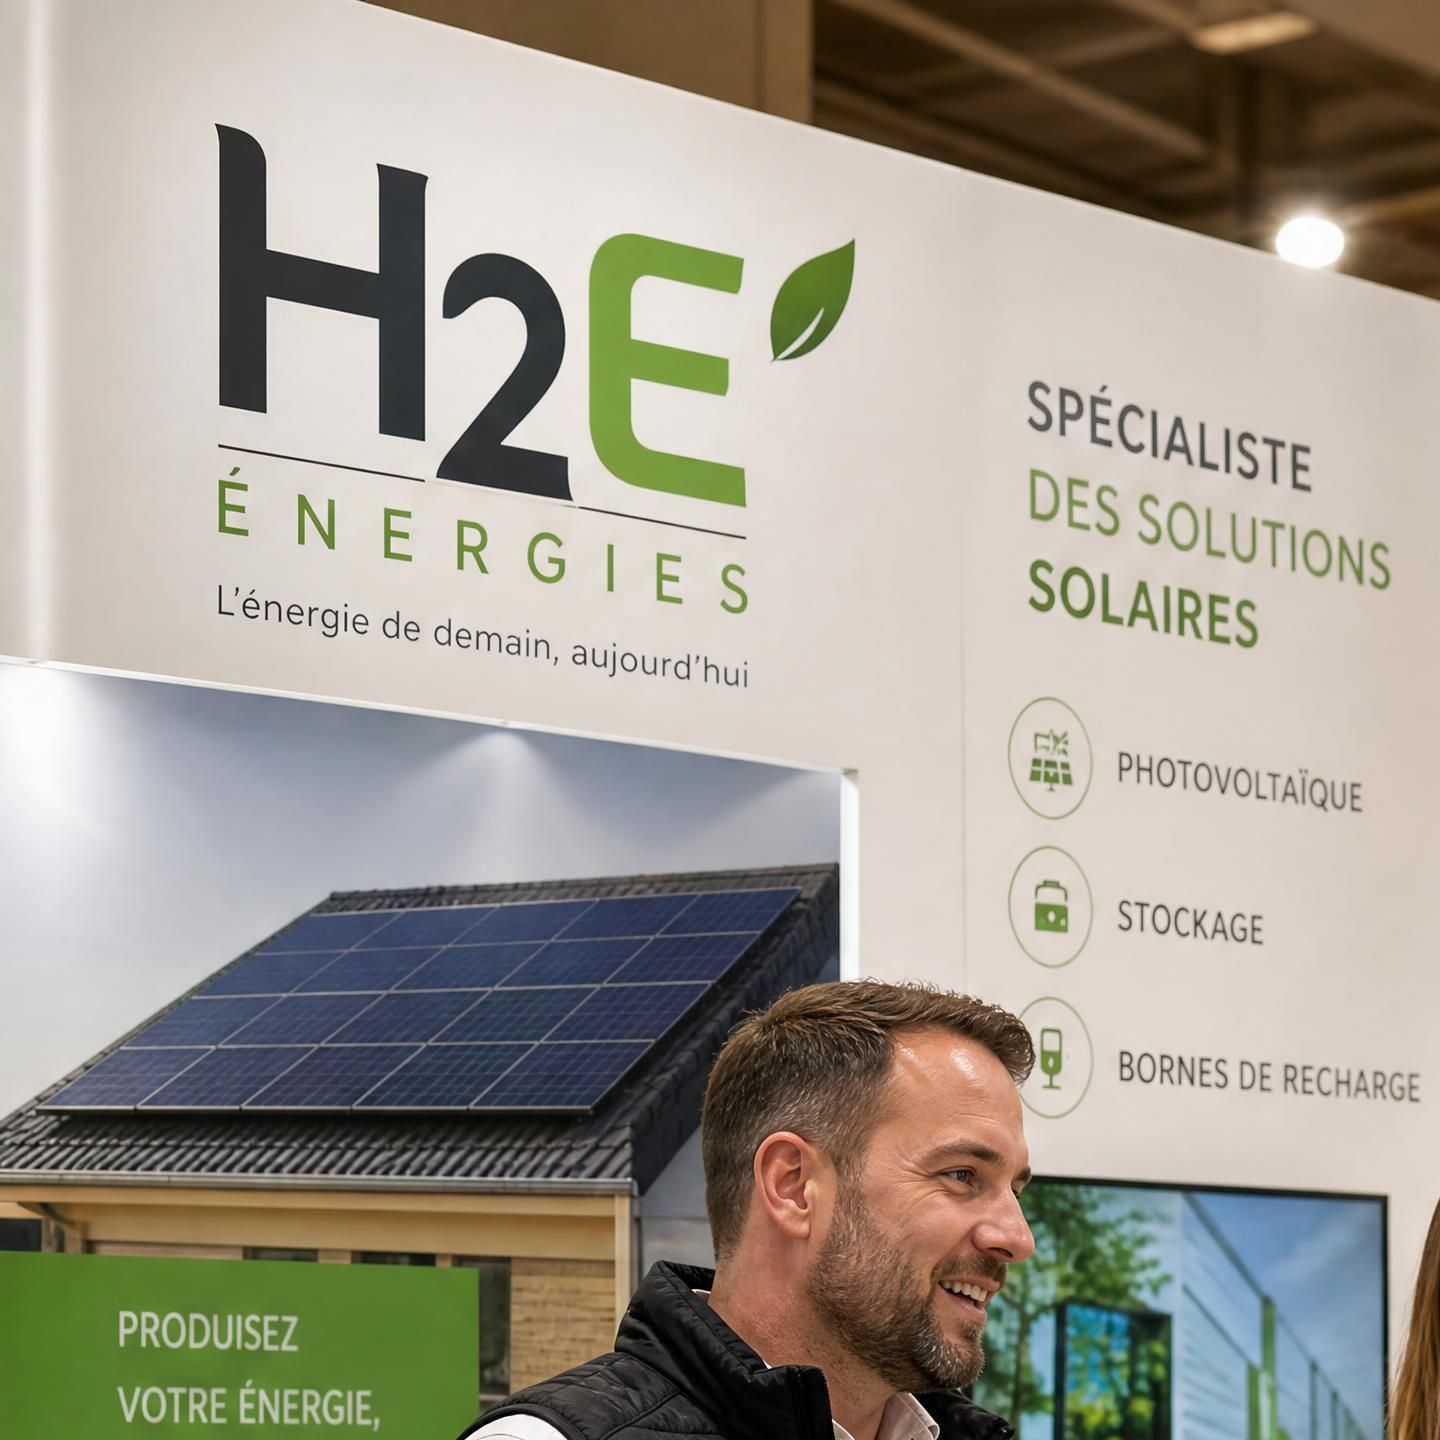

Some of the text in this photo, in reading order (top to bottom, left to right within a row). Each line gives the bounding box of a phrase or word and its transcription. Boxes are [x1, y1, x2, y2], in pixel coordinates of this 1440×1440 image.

[215, 123, 747, 508] H2E
[1027, 380, 1312, 493] SPÉCIALISTE
[217, 467, 748, 614] ÉNERGIES
[1029, 467, 1391, 591] DES SOLUTIONS
[217, 584, 749, 688] L’énergie de demain, aujourd’hui
[1028, 558, 1259, 649] SOLAIRES
[1118, 751, 1363, 813] PHOTOVOLTAÏQUE
[1117, 900, 1264, 945] STOCKAGE
[1119, 1050, 1421, 1103] BORNES DE RECHARGE
[118, 1310, 299, 1351] PRODUISEZ
[117, 1379, 381, 1432] VOTRE ÉNERGIE,
